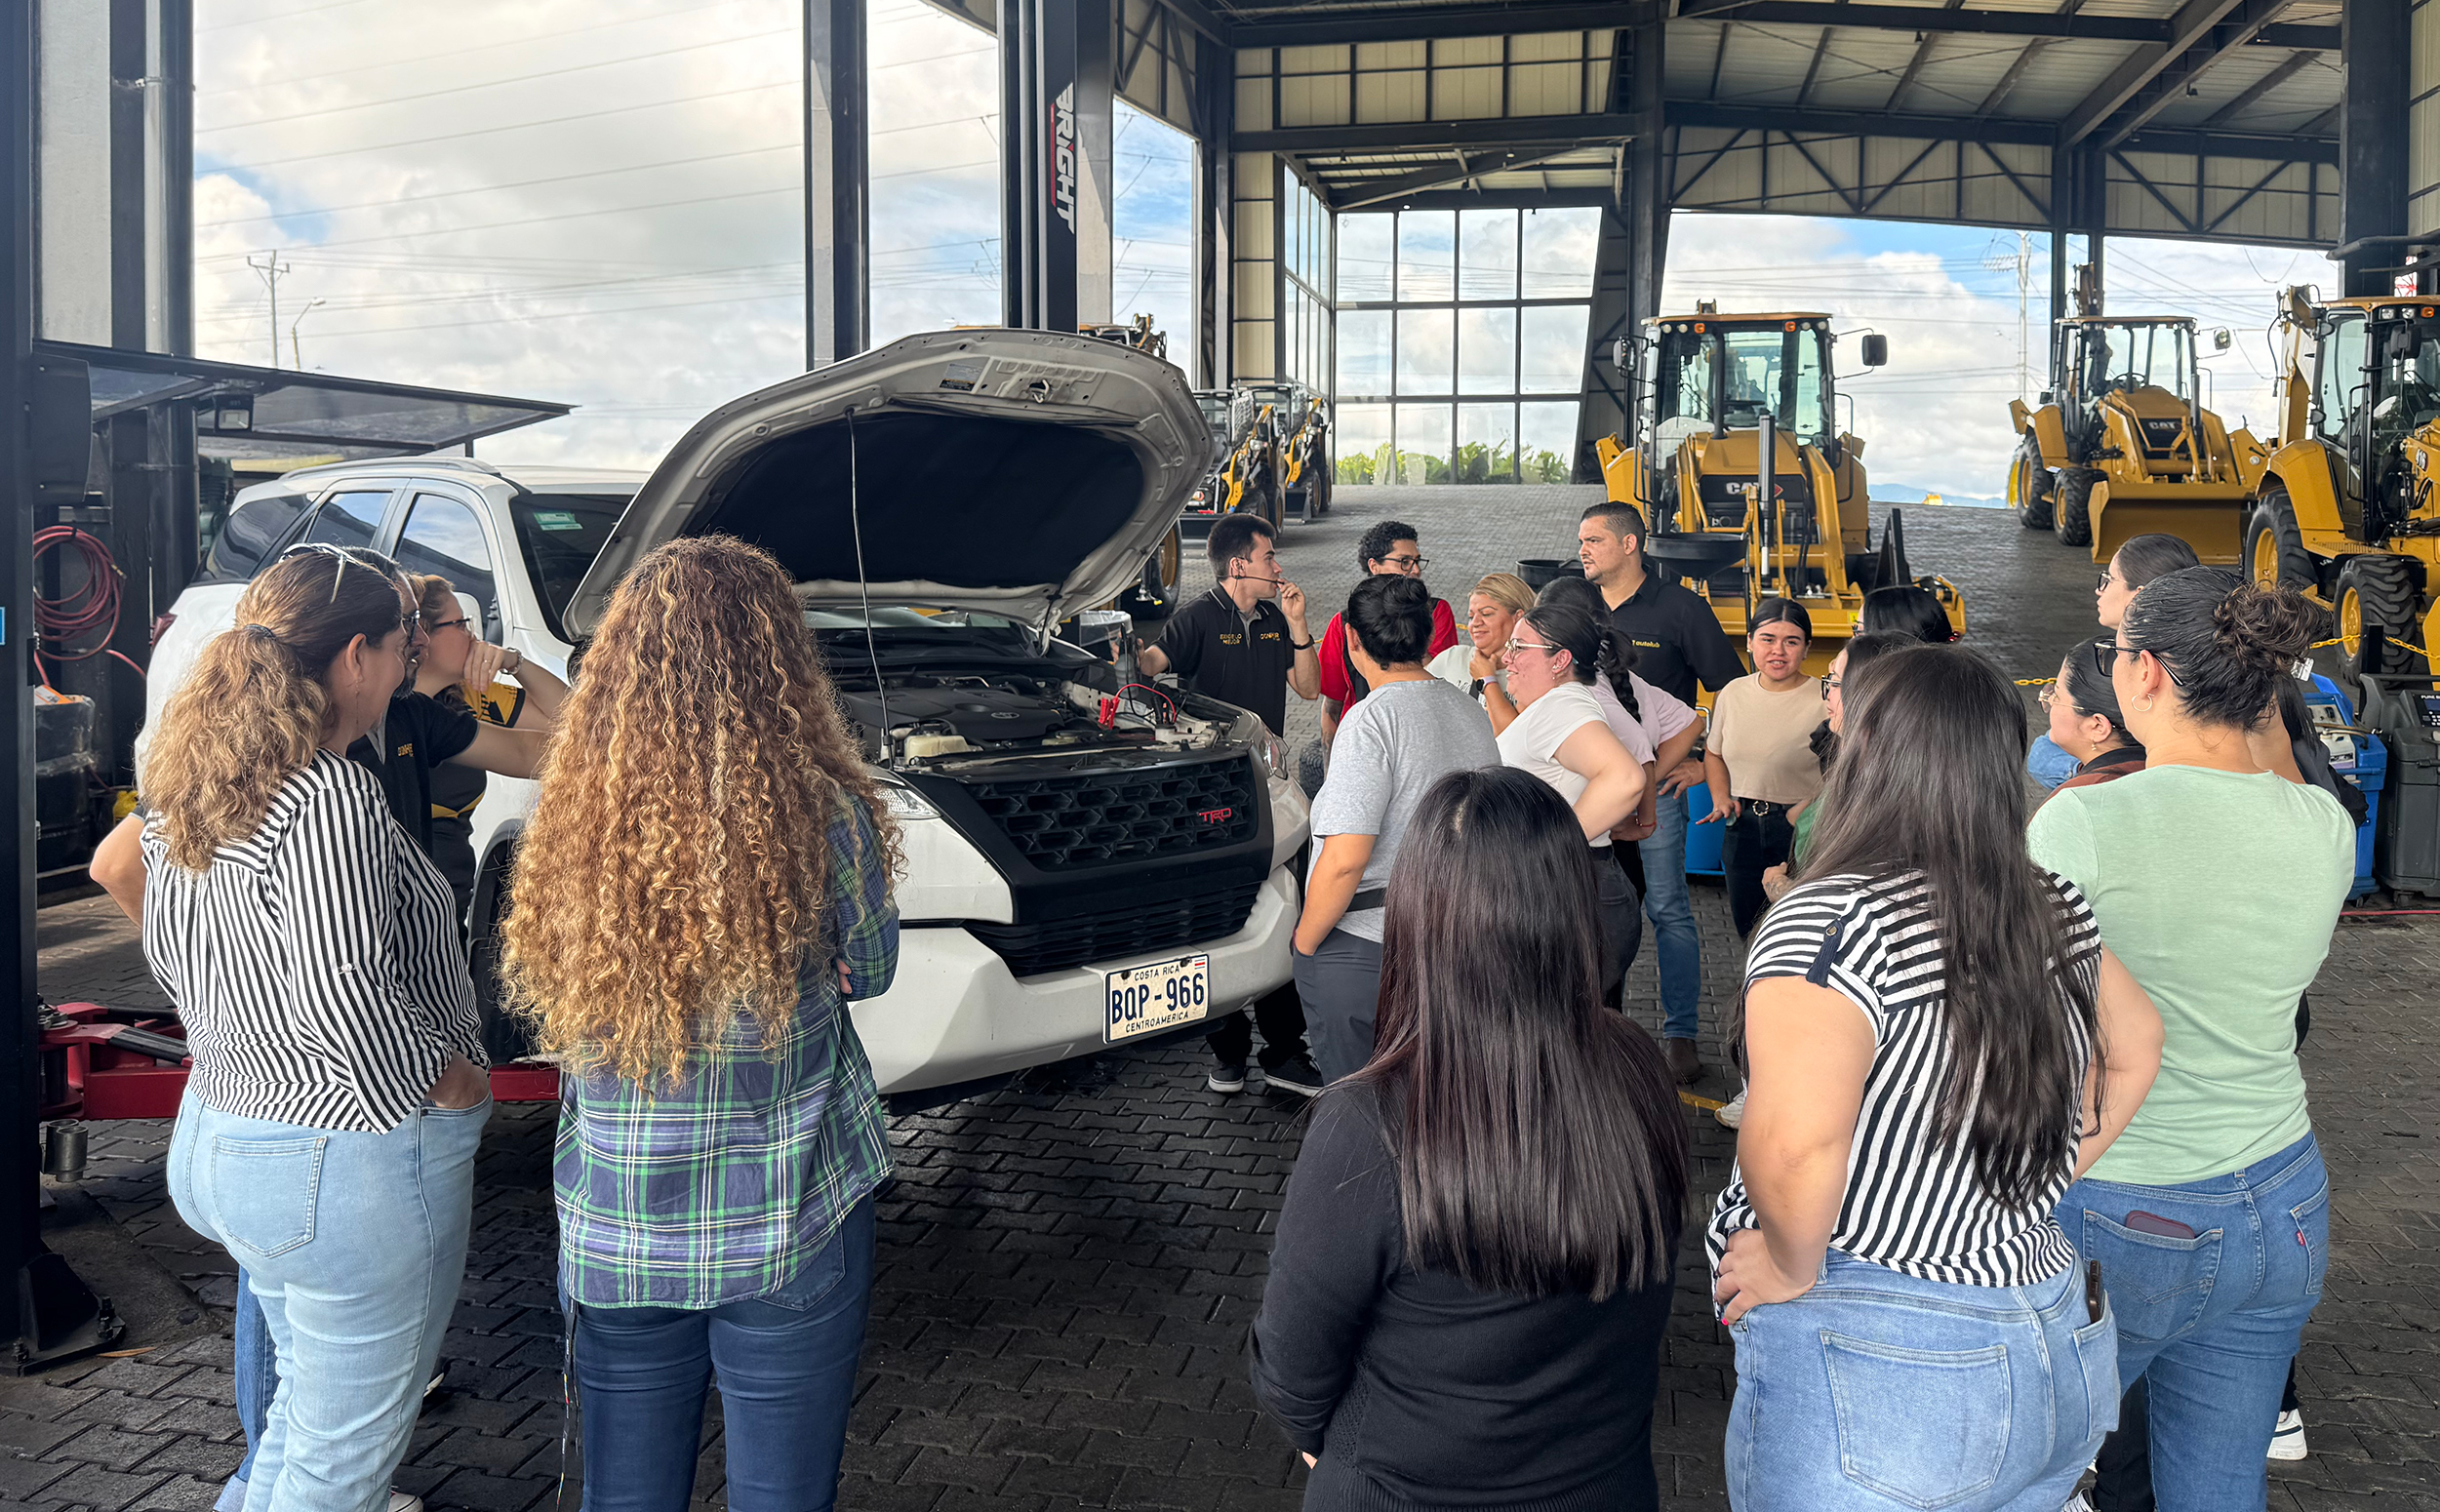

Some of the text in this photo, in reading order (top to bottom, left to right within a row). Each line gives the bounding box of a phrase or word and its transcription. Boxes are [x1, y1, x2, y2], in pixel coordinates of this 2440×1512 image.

[1056, 82, 1075, 235] BRIGHT
[1199, 808, 1232, 824] TRD
[1135, 965, 1180, 981] COSTA RICA
[1111, 974, 1205, 1025] BQP-966
[1125, 1012, 1189, 1033] CENTROAMERICA
